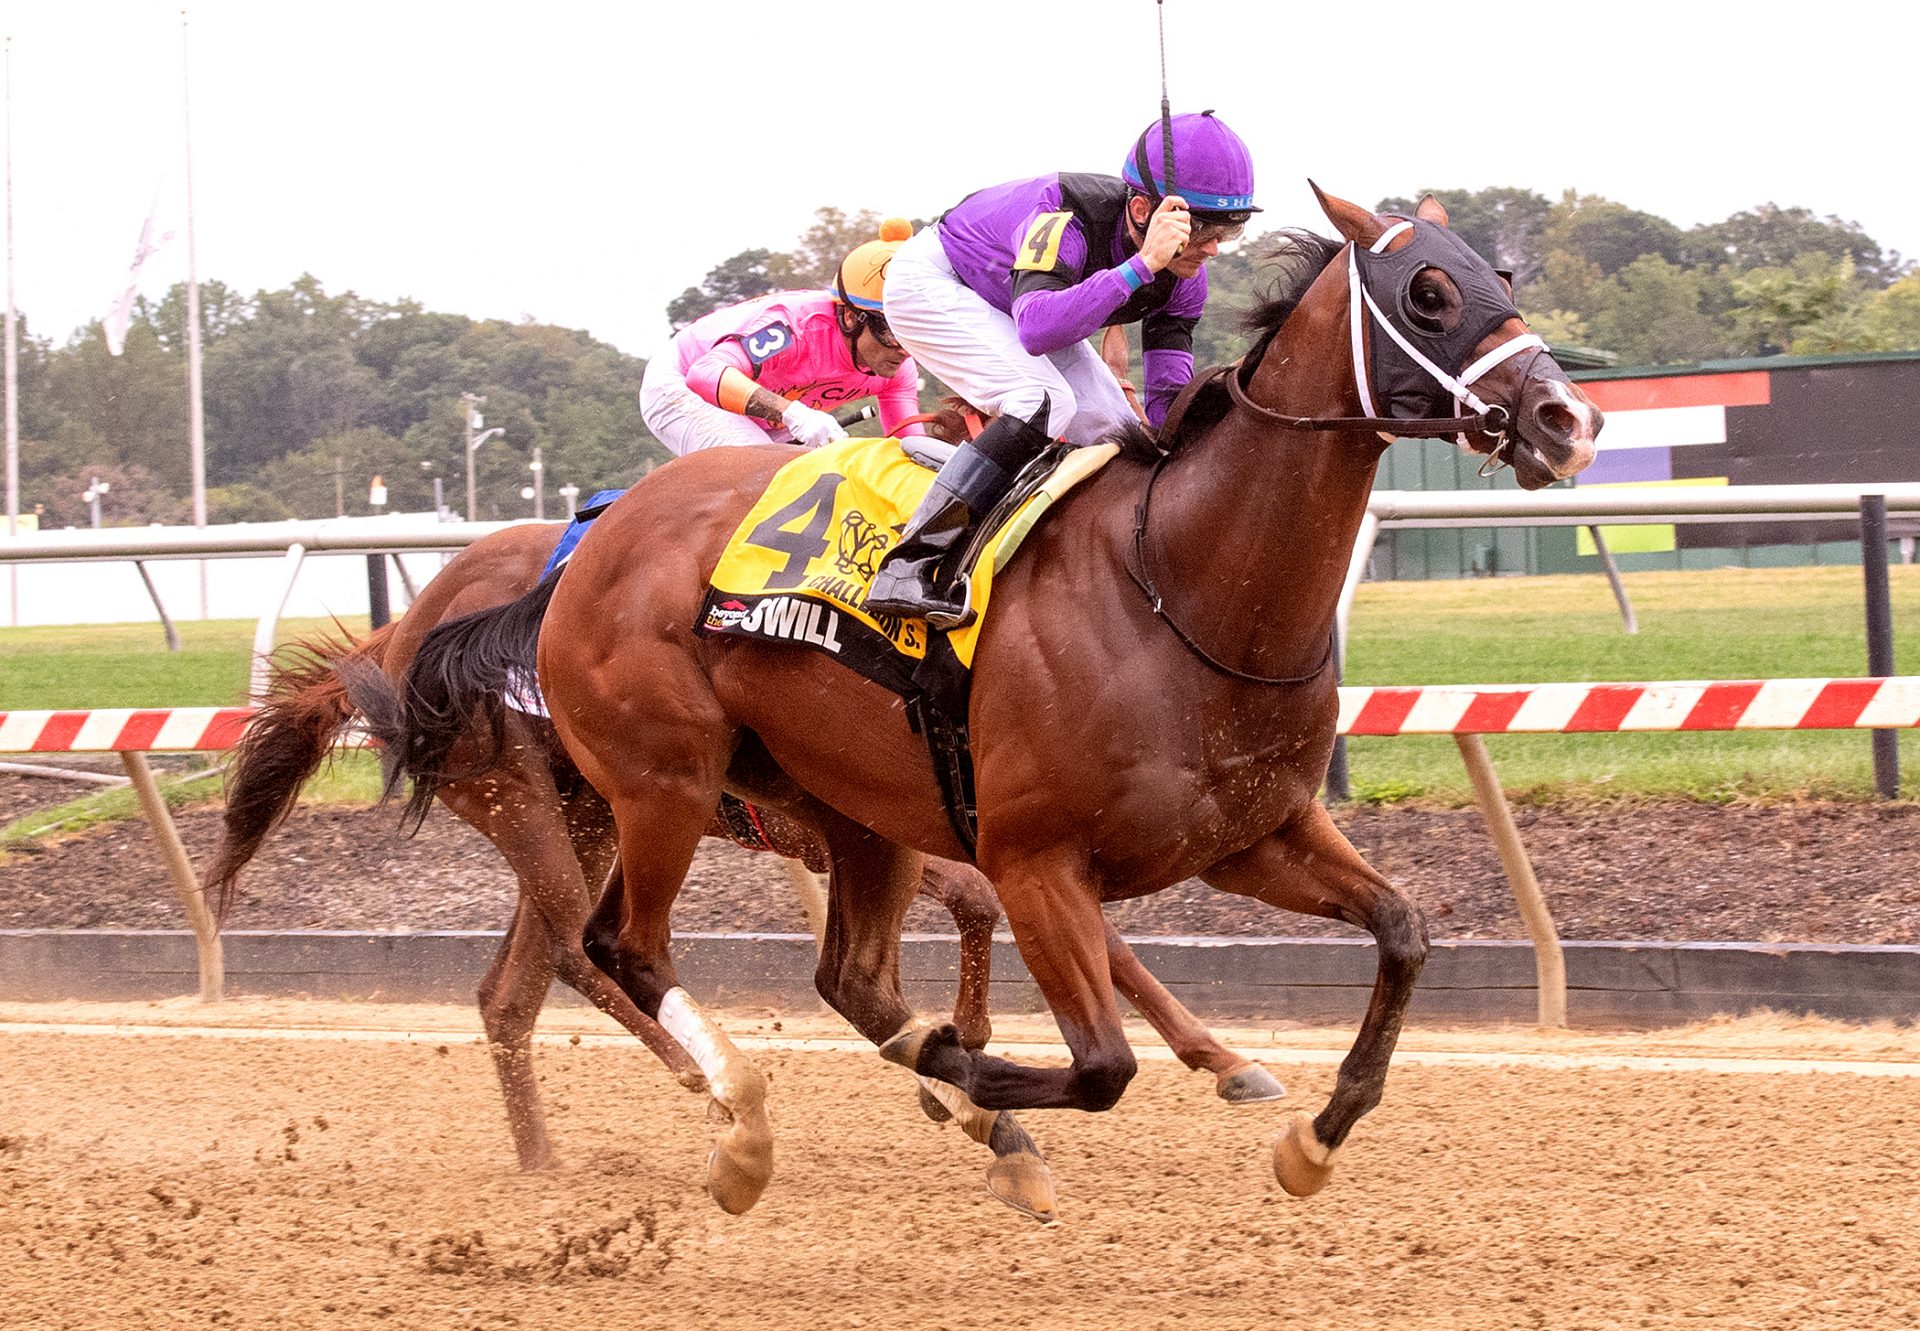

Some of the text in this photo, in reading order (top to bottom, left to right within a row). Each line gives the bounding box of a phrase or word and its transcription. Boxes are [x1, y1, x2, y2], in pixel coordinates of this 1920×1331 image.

[1028, 216, 1057, 264] 4
[749, 328, 785, 358] 3
[746, 473, 846, 589] 4
[904, 623, 921, 650] S.
